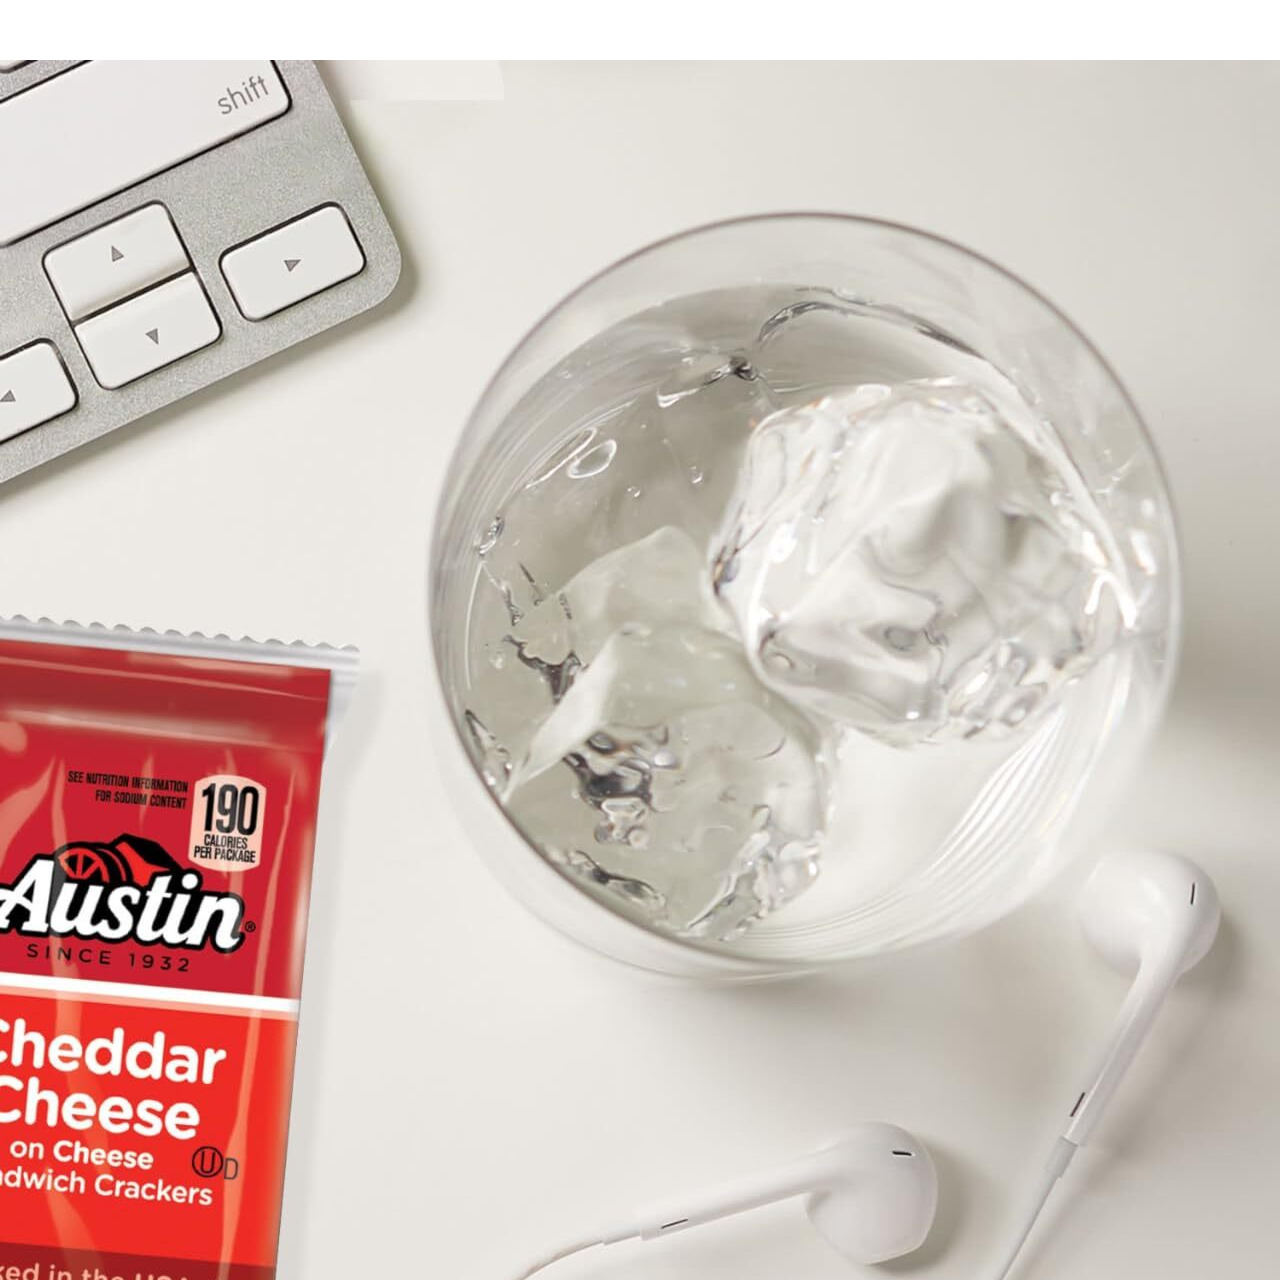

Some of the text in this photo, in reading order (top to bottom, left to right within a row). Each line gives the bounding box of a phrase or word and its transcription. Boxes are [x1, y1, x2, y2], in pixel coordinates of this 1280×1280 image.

[216, 75, 270, 116] shift
[68, 770, 189, 793] SEE NUTRITION INFORMATION
[95, 789, 188, 809] FOR SODIUM CONTENT
[201, 783, 260, 836] 190
[194, 846, 256, 863] PER PACKAGE
[204, 834, 248, 849] CALORIES
[26, 942, 190, 973] SINCE 1932
[10, 1140, 154, 1170] on Cheese
[94, 1174, 213, 1206] Crackers
